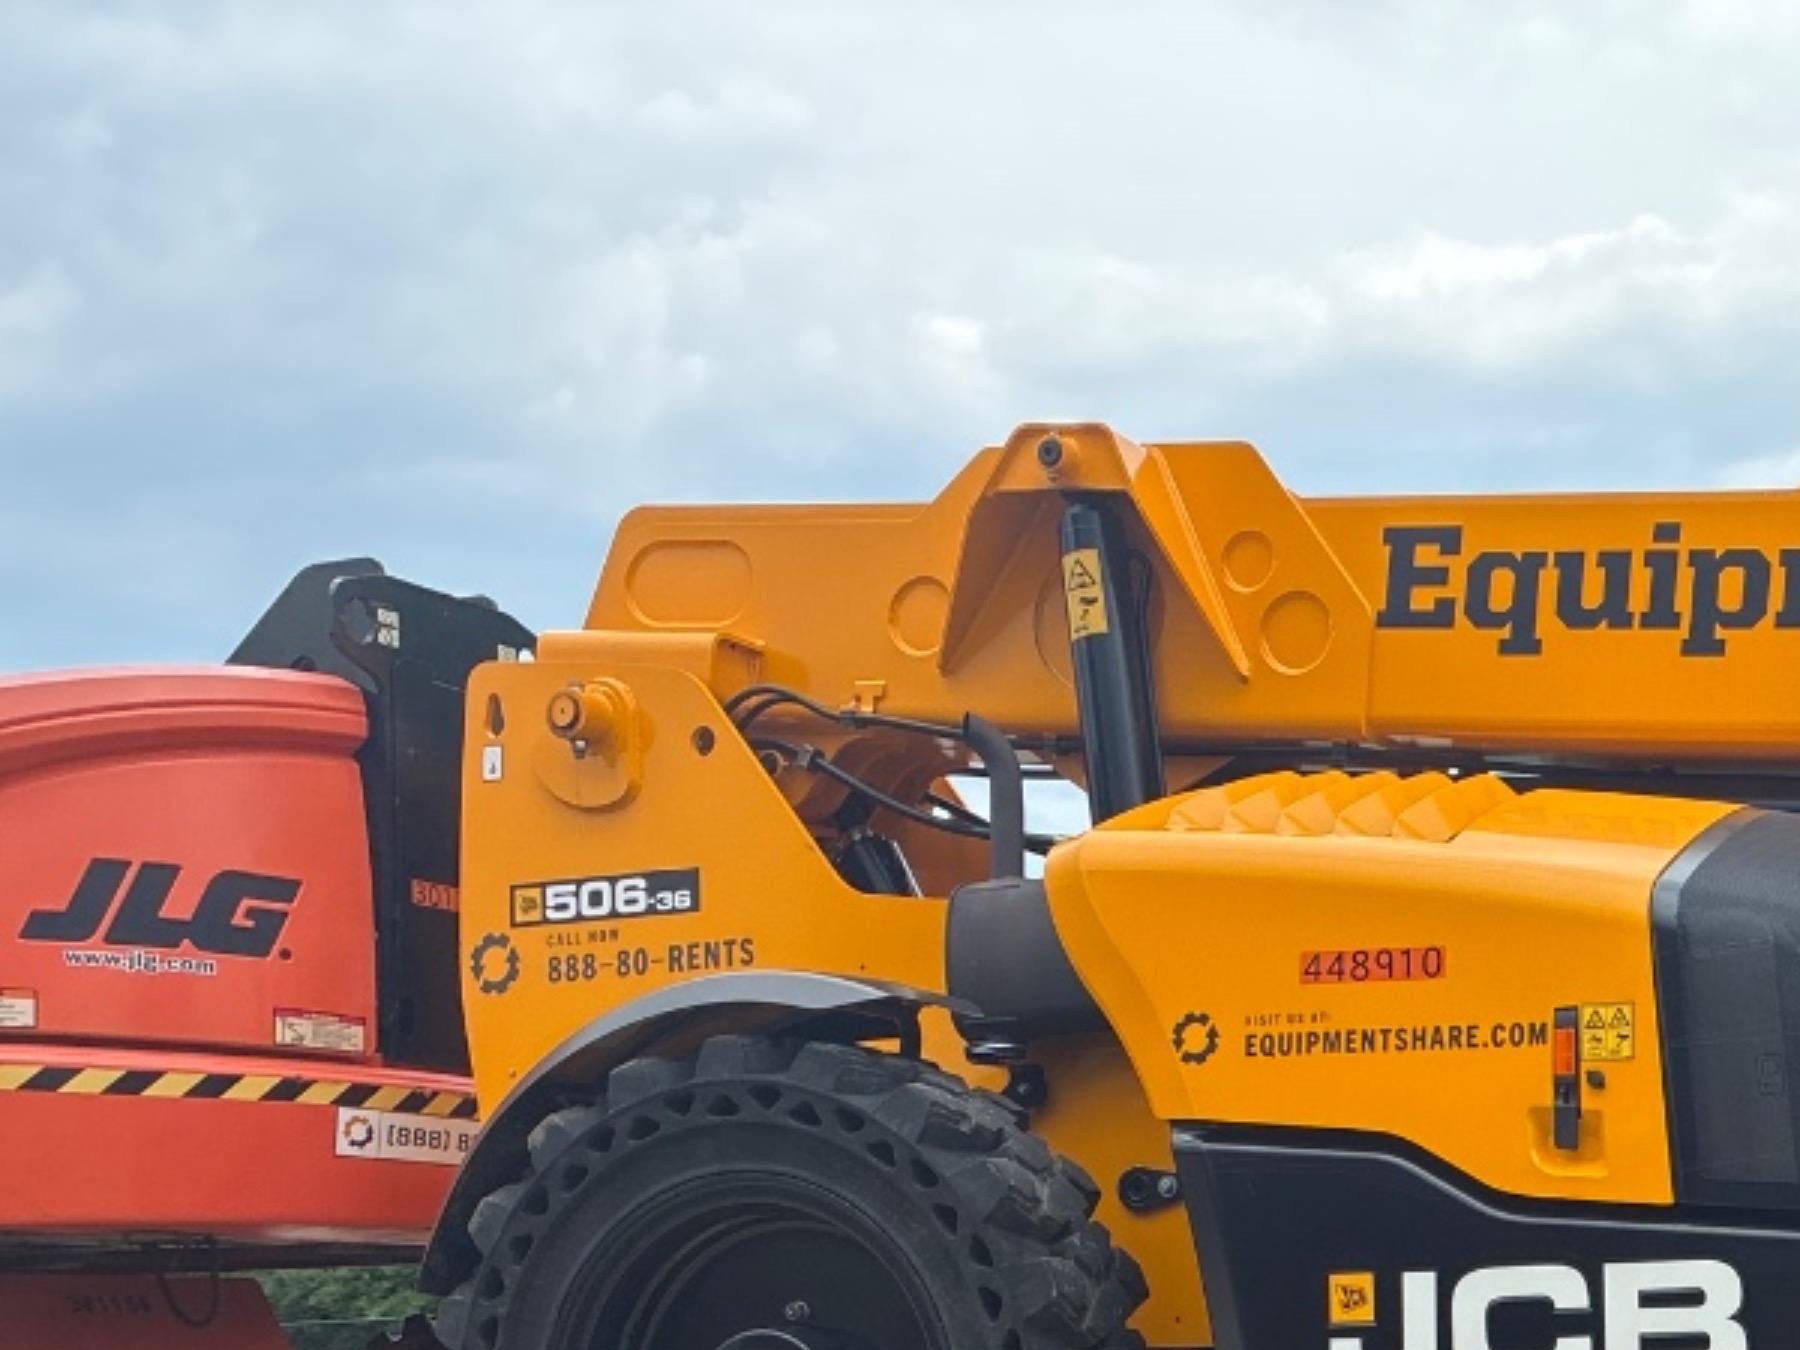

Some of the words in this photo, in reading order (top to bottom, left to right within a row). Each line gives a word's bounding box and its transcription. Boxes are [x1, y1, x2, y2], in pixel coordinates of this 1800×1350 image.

[18, 857, 302, 958] JLG
[545, 877, 691, 920] 506-36
[64, 950, 216, 975] www.jlg.com
[548, 938, 754, 982] 888-80-RENTS
[1303, 946, 1442, 982] 448910
[1245, 1022, 1548, 1057] EQUIPMENTSHARE.COM
